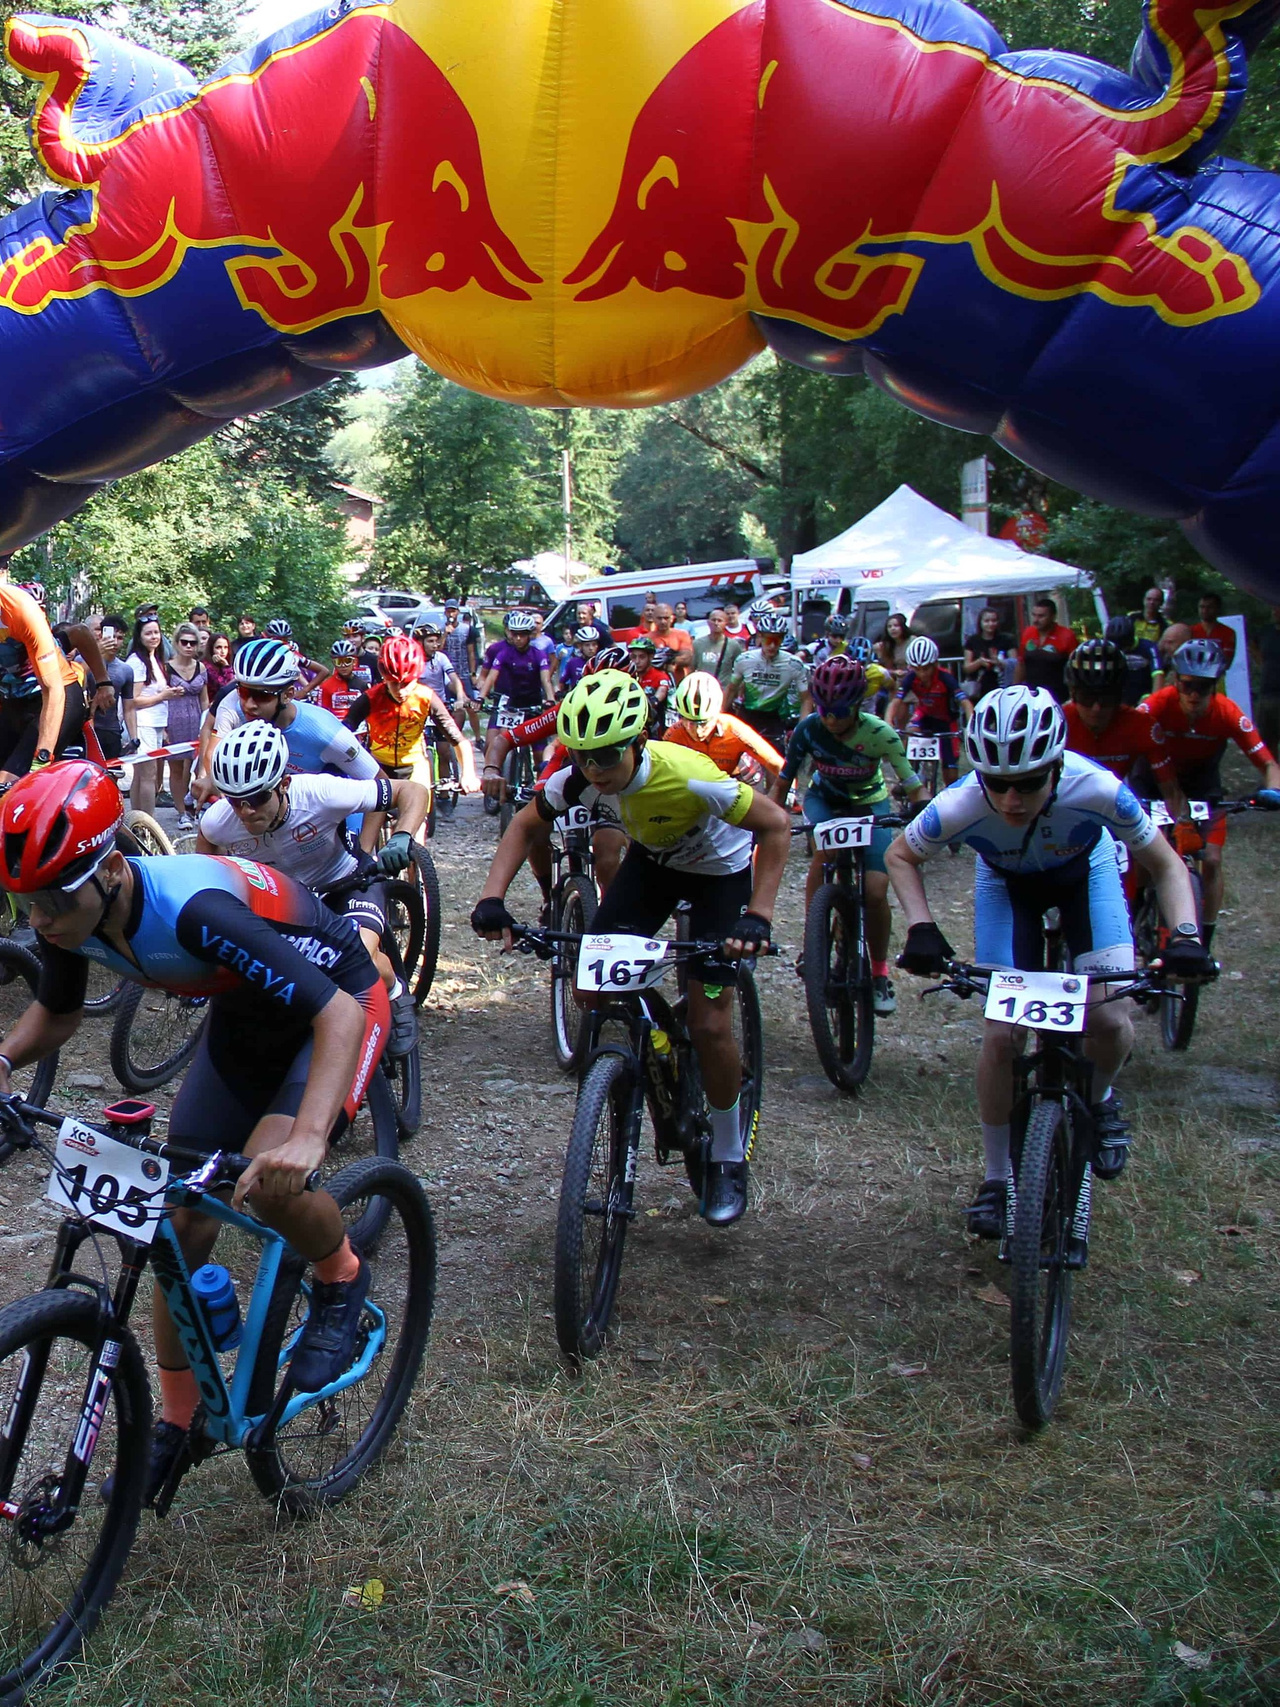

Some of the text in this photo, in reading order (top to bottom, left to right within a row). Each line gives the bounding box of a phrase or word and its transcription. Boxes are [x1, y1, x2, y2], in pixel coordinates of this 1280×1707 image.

[910, 747, 936, 758] 133
[821, 826, 864, 846] 101
[200, 925, 296, 1006] VEREYA
[588, 958, 656, 986] 167
[998, 996, 1075, 1026] 163
[65, 1162, 153, 1229] 105
